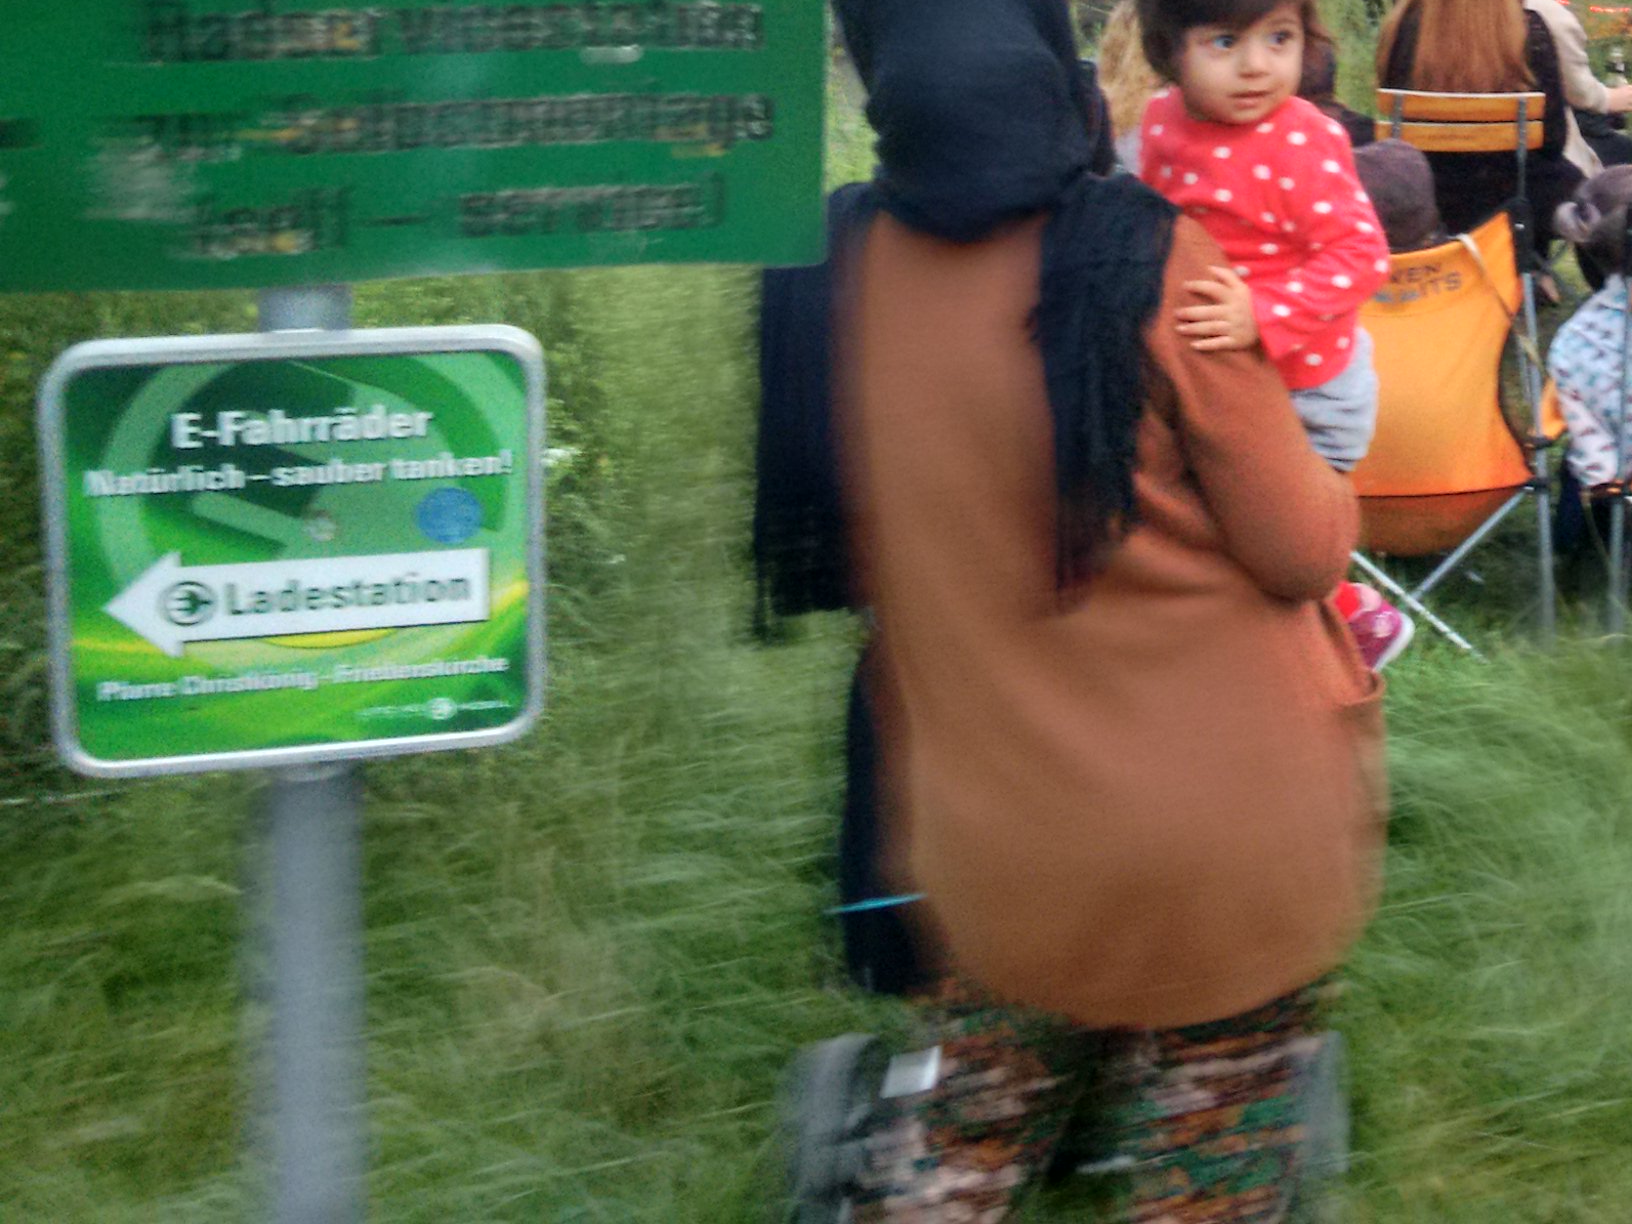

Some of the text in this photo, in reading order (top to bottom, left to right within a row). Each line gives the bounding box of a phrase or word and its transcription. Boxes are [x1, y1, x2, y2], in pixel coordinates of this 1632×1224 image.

[170, 404, 435, 450] E-Fahrräder
[84, 462, 246, 496] Natürlich
[271, 458, 386, 487] sauber
[388, 450, 513, 481] tanken!
[225, 571, 471, 616] Ladestation
